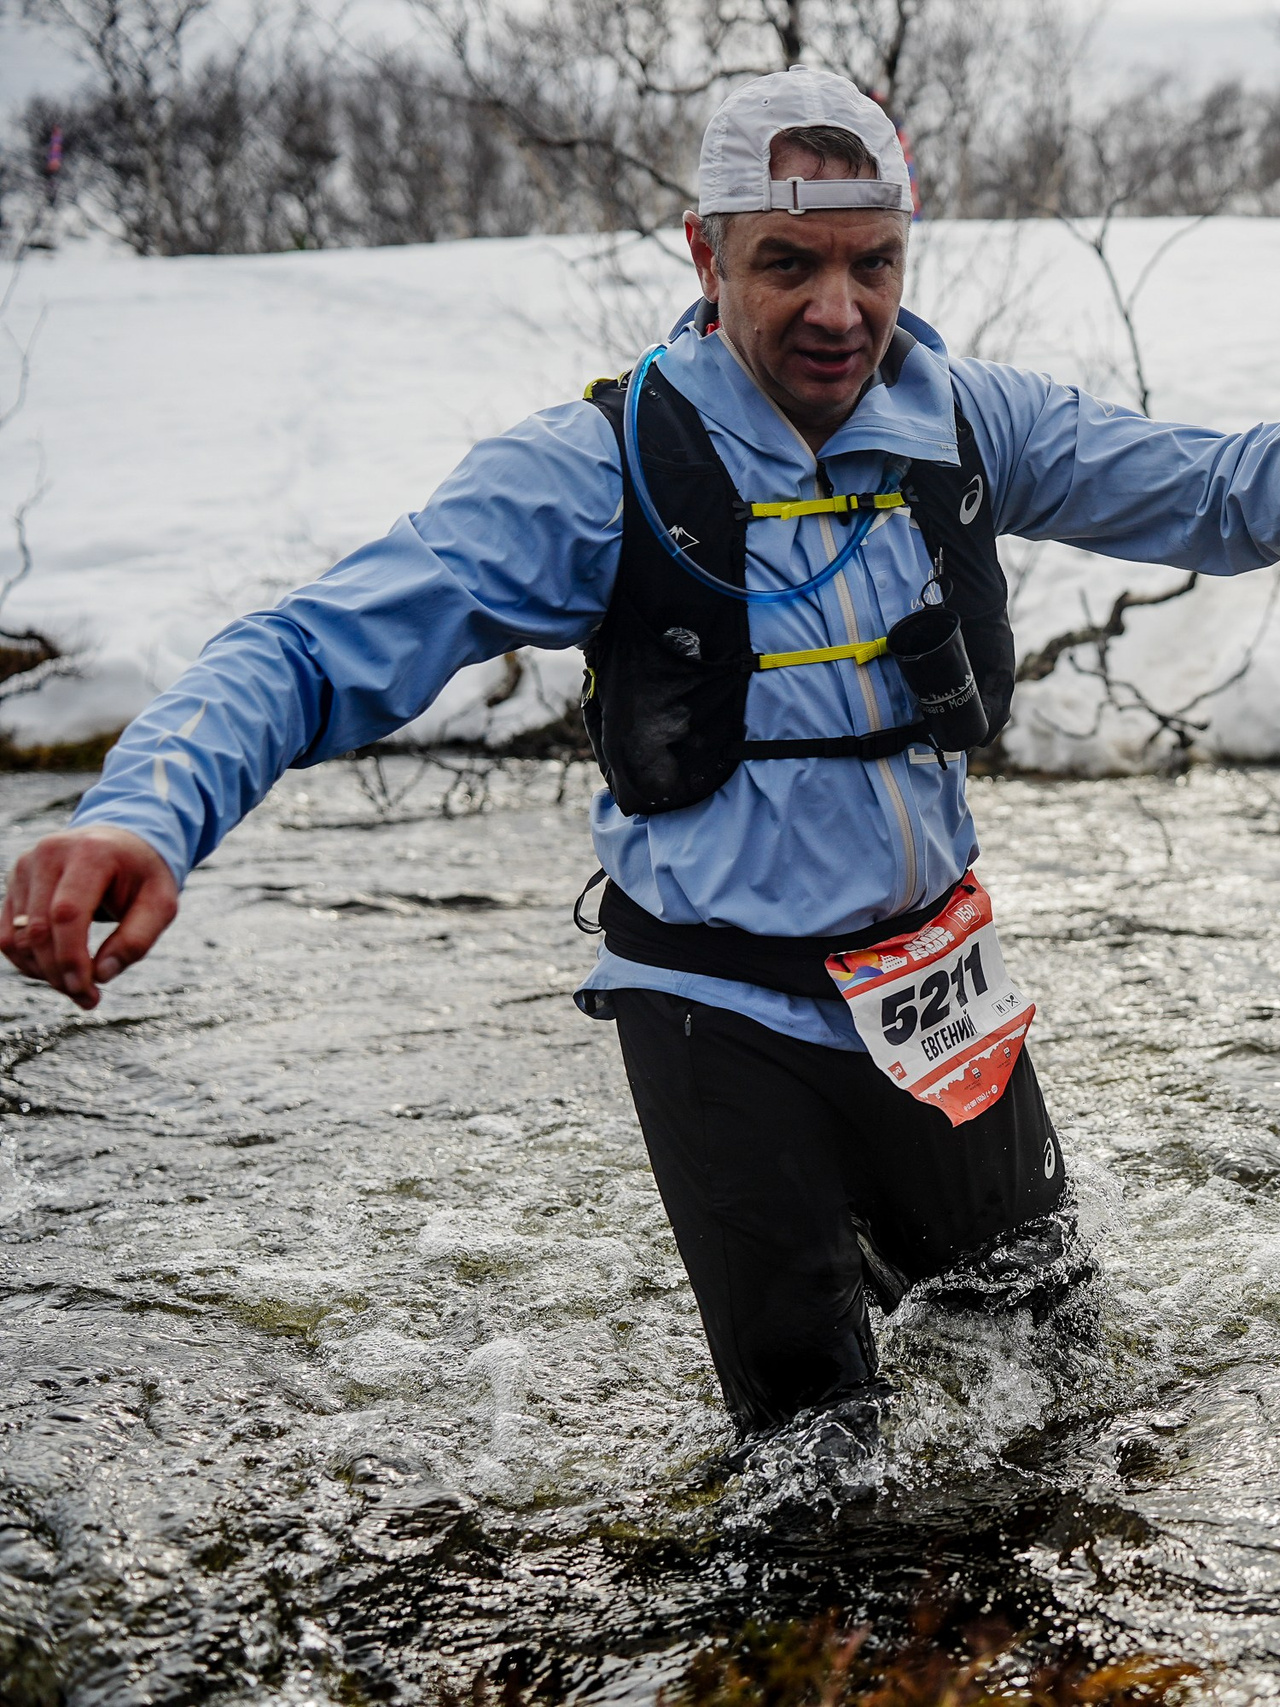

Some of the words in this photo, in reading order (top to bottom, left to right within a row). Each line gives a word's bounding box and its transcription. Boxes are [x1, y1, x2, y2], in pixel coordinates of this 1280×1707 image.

[953, 903, 975, 924] R50
[880, 942, 988, 1046] 5211
[920, 1008, 978, 1063] ЕВГЕНИЙ
